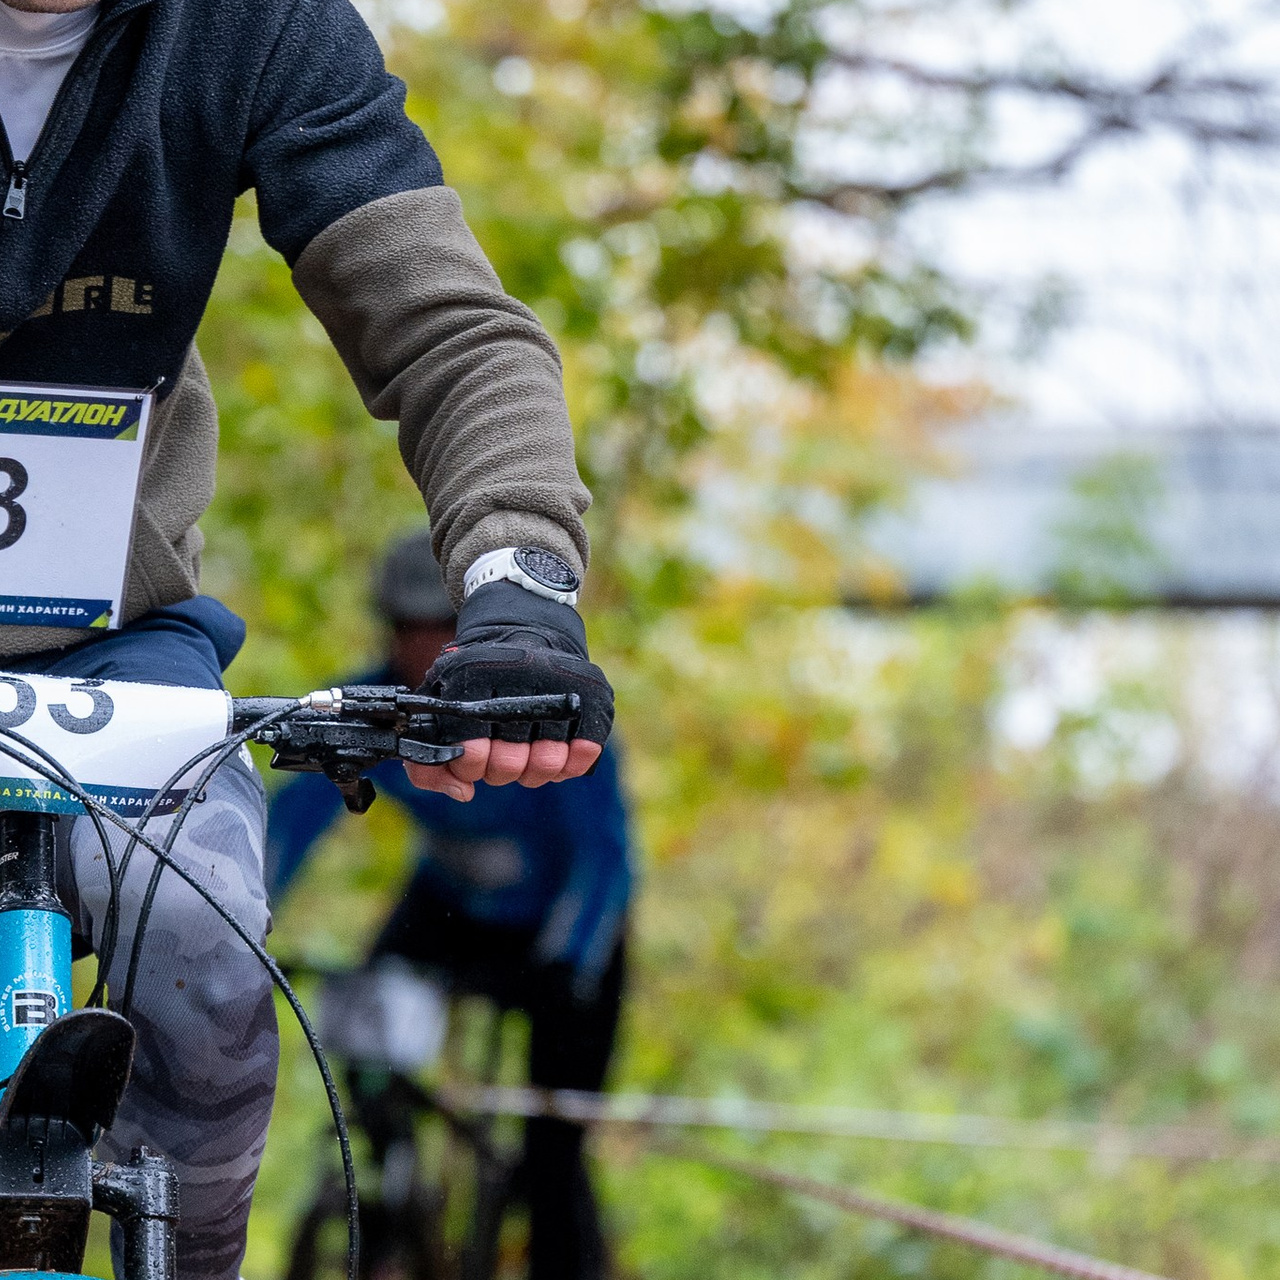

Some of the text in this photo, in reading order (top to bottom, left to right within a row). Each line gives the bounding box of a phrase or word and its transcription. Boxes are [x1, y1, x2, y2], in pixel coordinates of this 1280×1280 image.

[17, 604, 90, 617] ХАРАКТЕР.
[15, 788, 67, 801] ЭТАПА.
[69, 793, 108, 805] ОИН
[110, 795, 176, 807] ХАРАКЕР.
